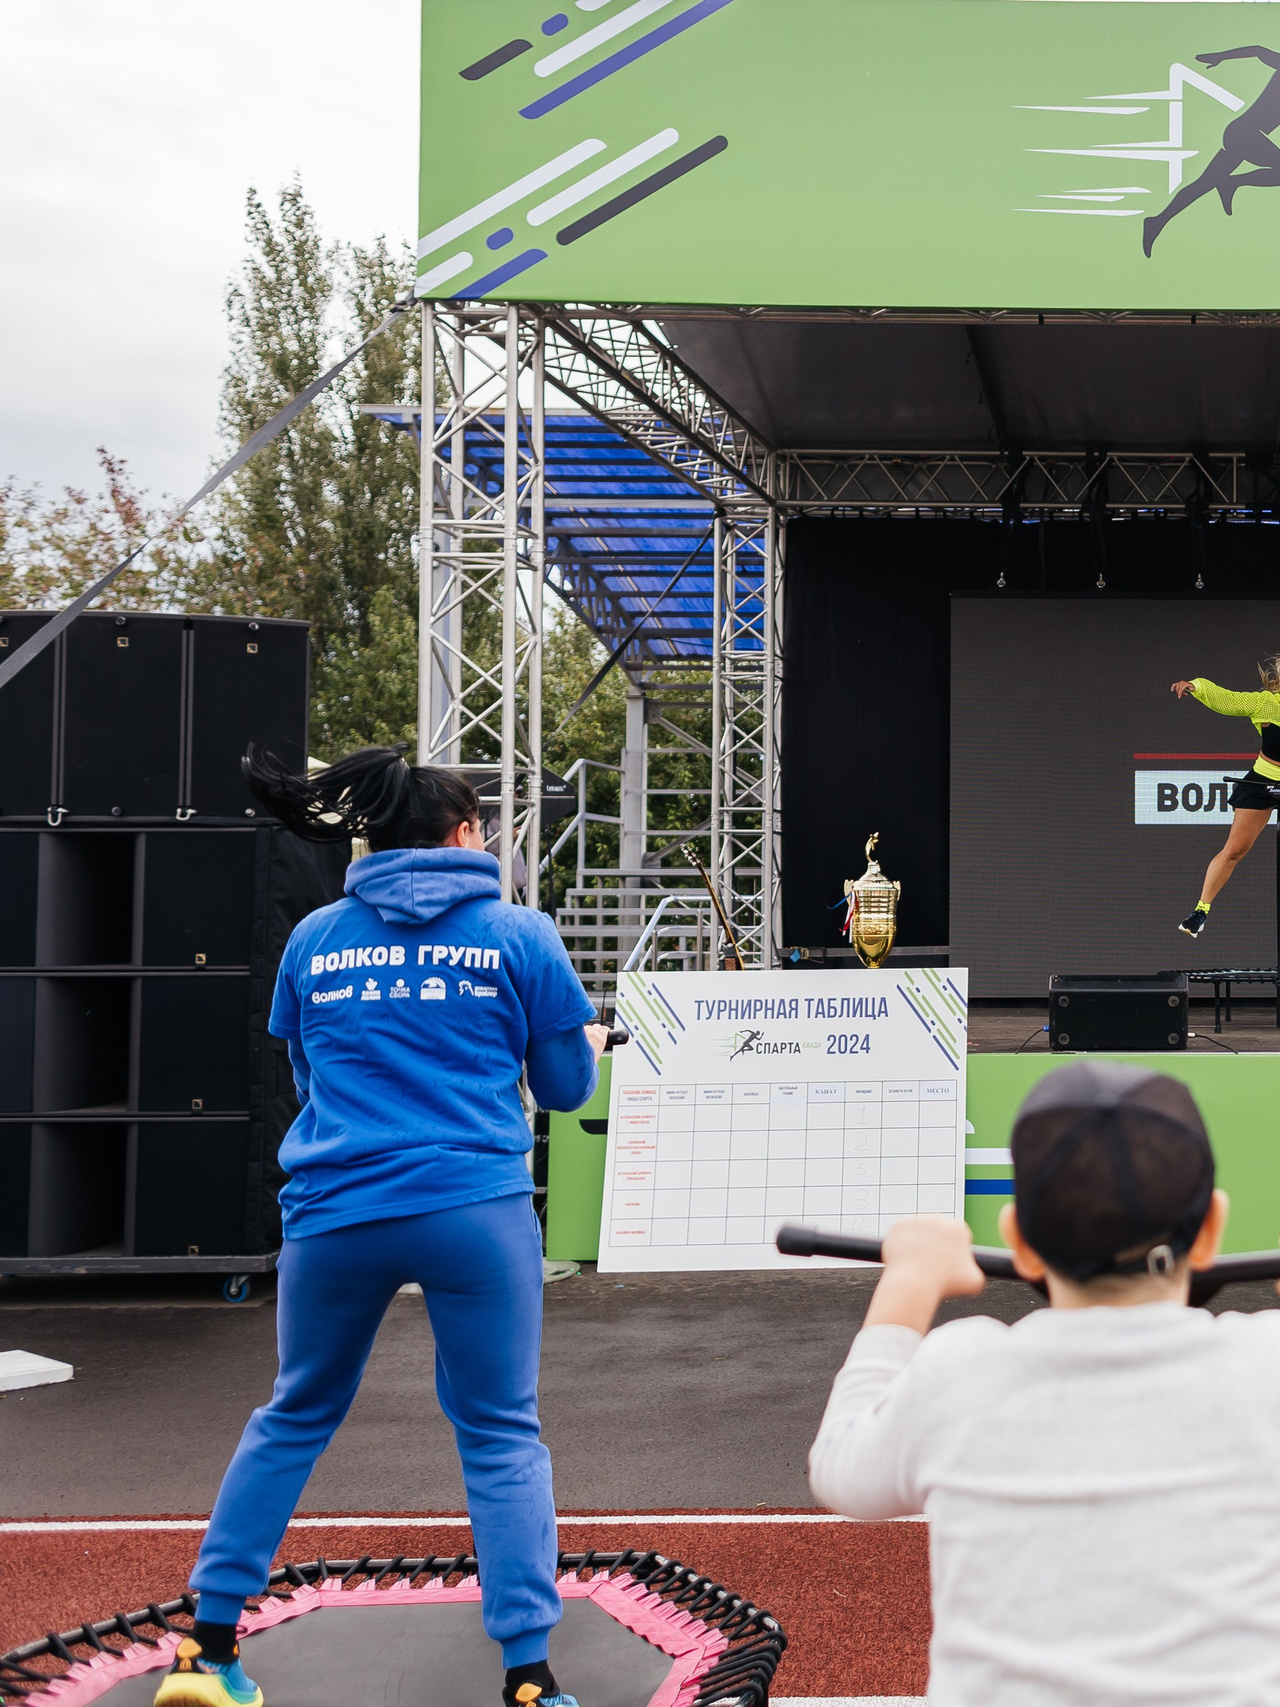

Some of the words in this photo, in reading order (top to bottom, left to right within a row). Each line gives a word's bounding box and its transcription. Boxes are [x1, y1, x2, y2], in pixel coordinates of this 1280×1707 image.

[310, 945, 406, 976] ВОЛКОВ
[417, 945, 501, 970] ГРУПП
[694, 999, 799, 1021] ТУРНИРНАЯ
[804, 997, 889, 1020] ТАБЛИЦА
[755, 1042, 802, 1055] СПАРТА
[802, 1041, 822, 1050] КИАДА
[826, 1033, 871, 1055] 2024
[856, 1105, 869, 1125] 1
[854, 1131, 870, 1151] 2
[855, 1162, 868, 1176] 5
[853, 1188, 869, 1211] 3
